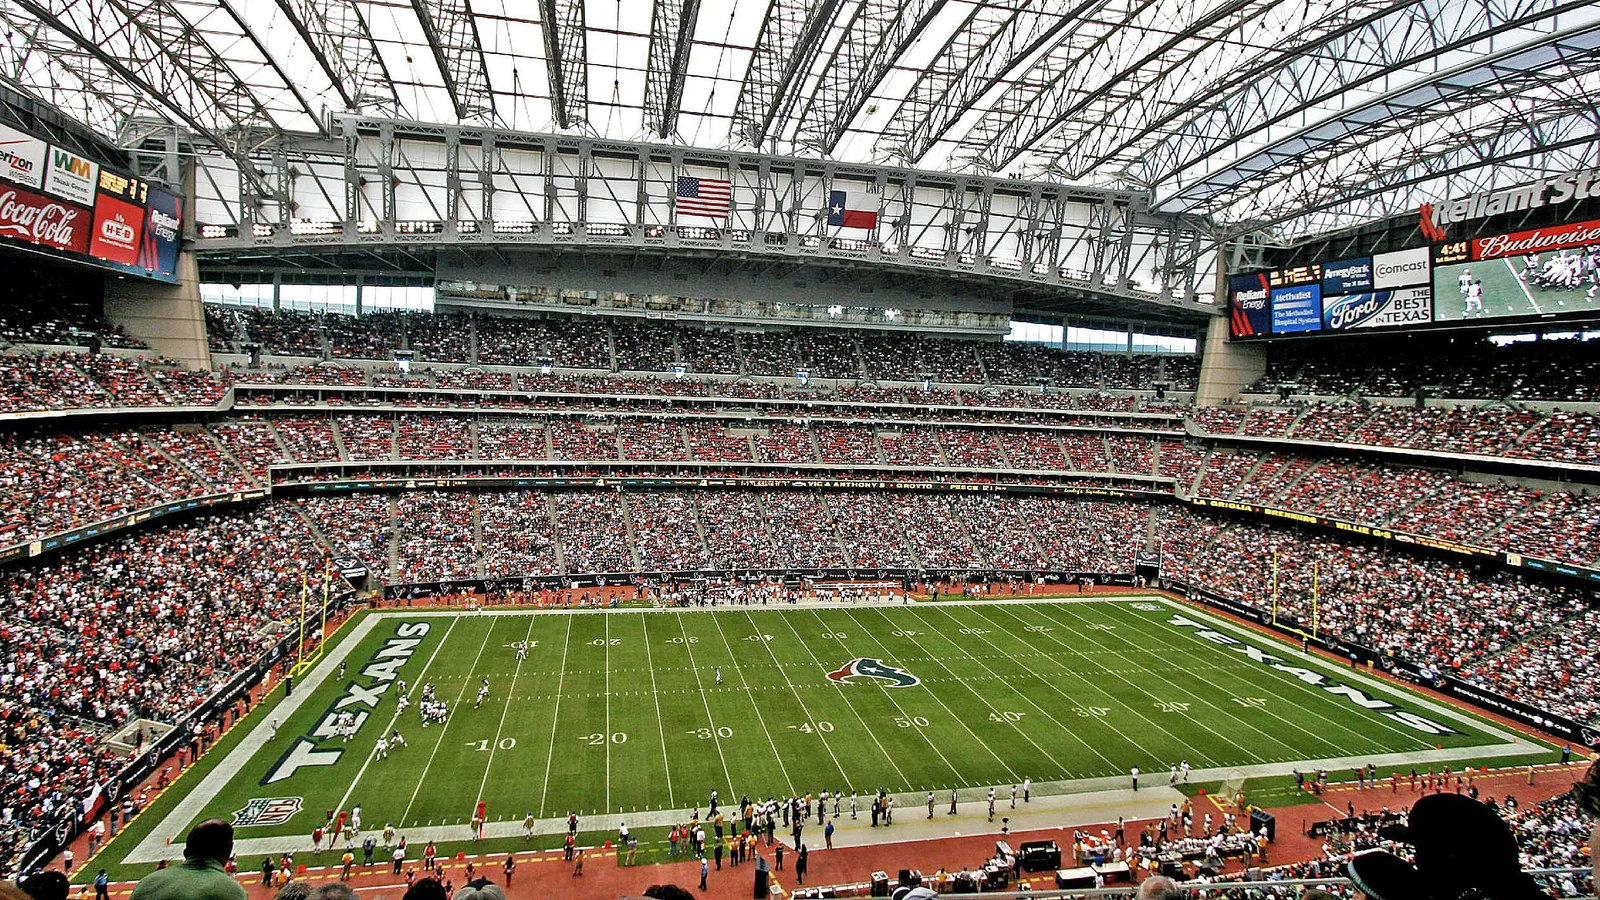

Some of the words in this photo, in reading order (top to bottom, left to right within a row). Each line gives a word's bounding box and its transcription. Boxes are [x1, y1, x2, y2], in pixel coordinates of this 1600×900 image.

[54, 150, 90, 180] WM
[8, 170, 38, 186] wireless
[1431, 179, 1548, 228] Reliant
[151, 209, 180, 230] Reliant
[1440, 241, 1467, 255] 4:41
[1236, 289, 1266, 302] Reliant
[1275, 291, 1312, 302] Methodist
[1412, 288, 1430, 298] THE
[1331, 292, 1378, 329] Ford
[1394, 297, 1430, 311] BEST
[1286, 309, 1314, 318] Methodist
[1384, 309, 1430, 323] TEXAS
[1299, 317, 1320, 325] System
[1210, 501, 1252, 512] GRIGLIA
[1335, 522, 1370, 535] WILLIE
[592, 638, 622, 646] 20
[672, 636, 700, 644] 30
[821, 632, 848, 640] 50
[1166, 613, 1464, 736] TEXANS
[259, 621, 431, 786] TEXANS
[1153, 701, 1190, 713] 20
[1232, 697, 1266, 708] 10
[988, 711, 1021, 722] 40
[1071, 706, 1107, 718] 30
[799, 721, 835, 734] 40
[894, 716, 930, 728] 50
[588, 732, 628, 746] 20
[696, 726, 734, 740] 30
[474, 737, 516, 752] 10
[256, 798, 296, 822] NFL
